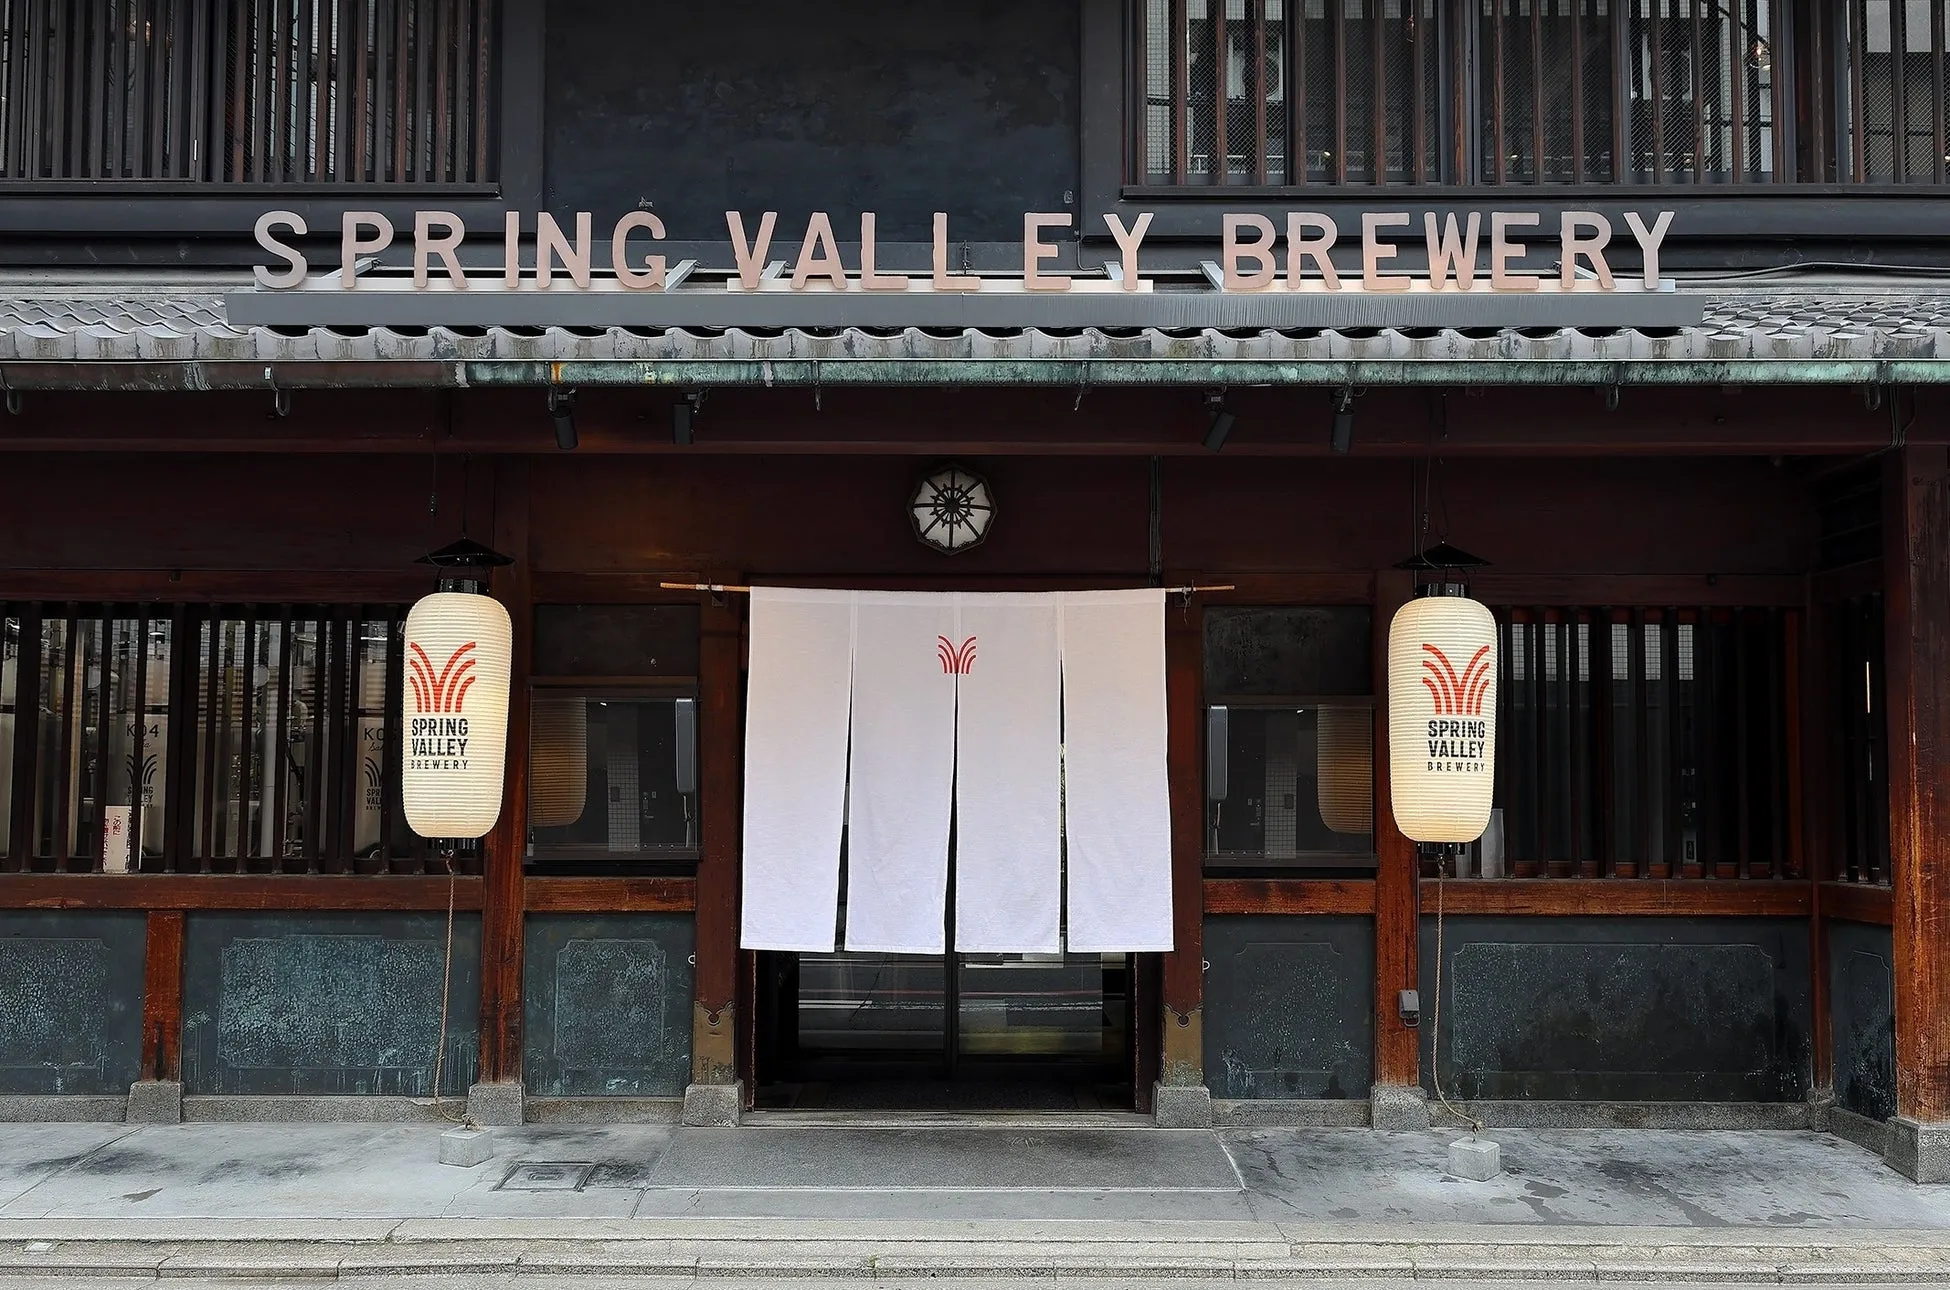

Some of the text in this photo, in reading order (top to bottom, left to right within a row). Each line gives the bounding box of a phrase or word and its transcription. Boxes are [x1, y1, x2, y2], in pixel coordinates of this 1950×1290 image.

[252, 210, 1676, 290] SPRING VALLEY BREWERY
[411, 718, 469, 737] SPRING
[1428, 719, 1486, 738] SPRING
[411, 738, 469, 757] VALLEY
[1428, 740, 1485, 758] VALLEY
[410, 759, 469, 770] BREWERY
[1427, 761, 1485, 772] BREWERY
